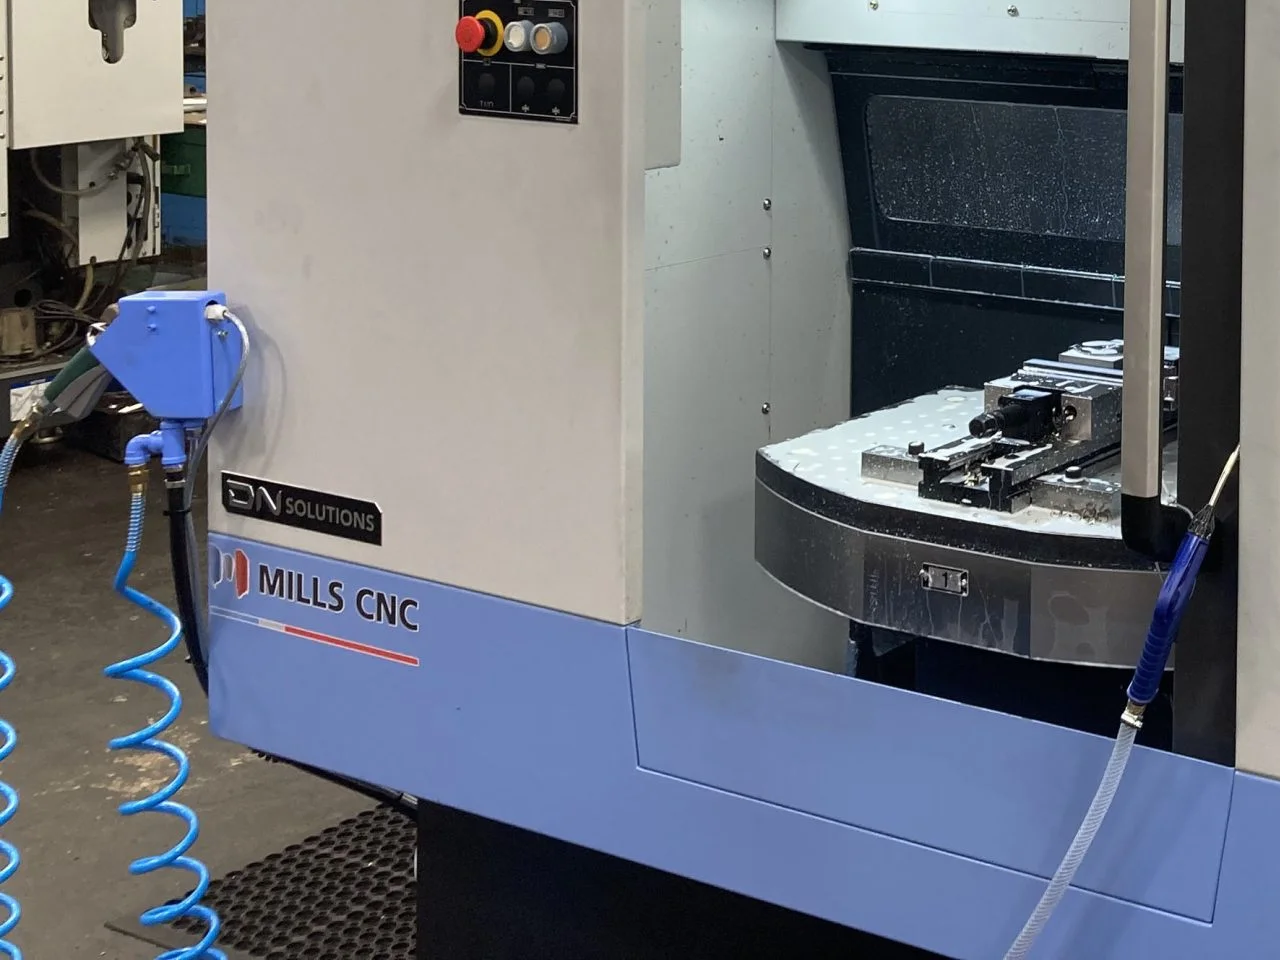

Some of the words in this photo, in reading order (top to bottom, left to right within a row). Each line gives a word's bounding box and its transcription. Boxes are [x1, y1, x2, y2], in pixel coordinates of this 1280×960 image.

[285, 497, 375, 532] SOLUTIONS
[258, 563, 345, 613] MILLS
[355, 587, 419, 632] CNC
[941, 572, 949, 588] 1
